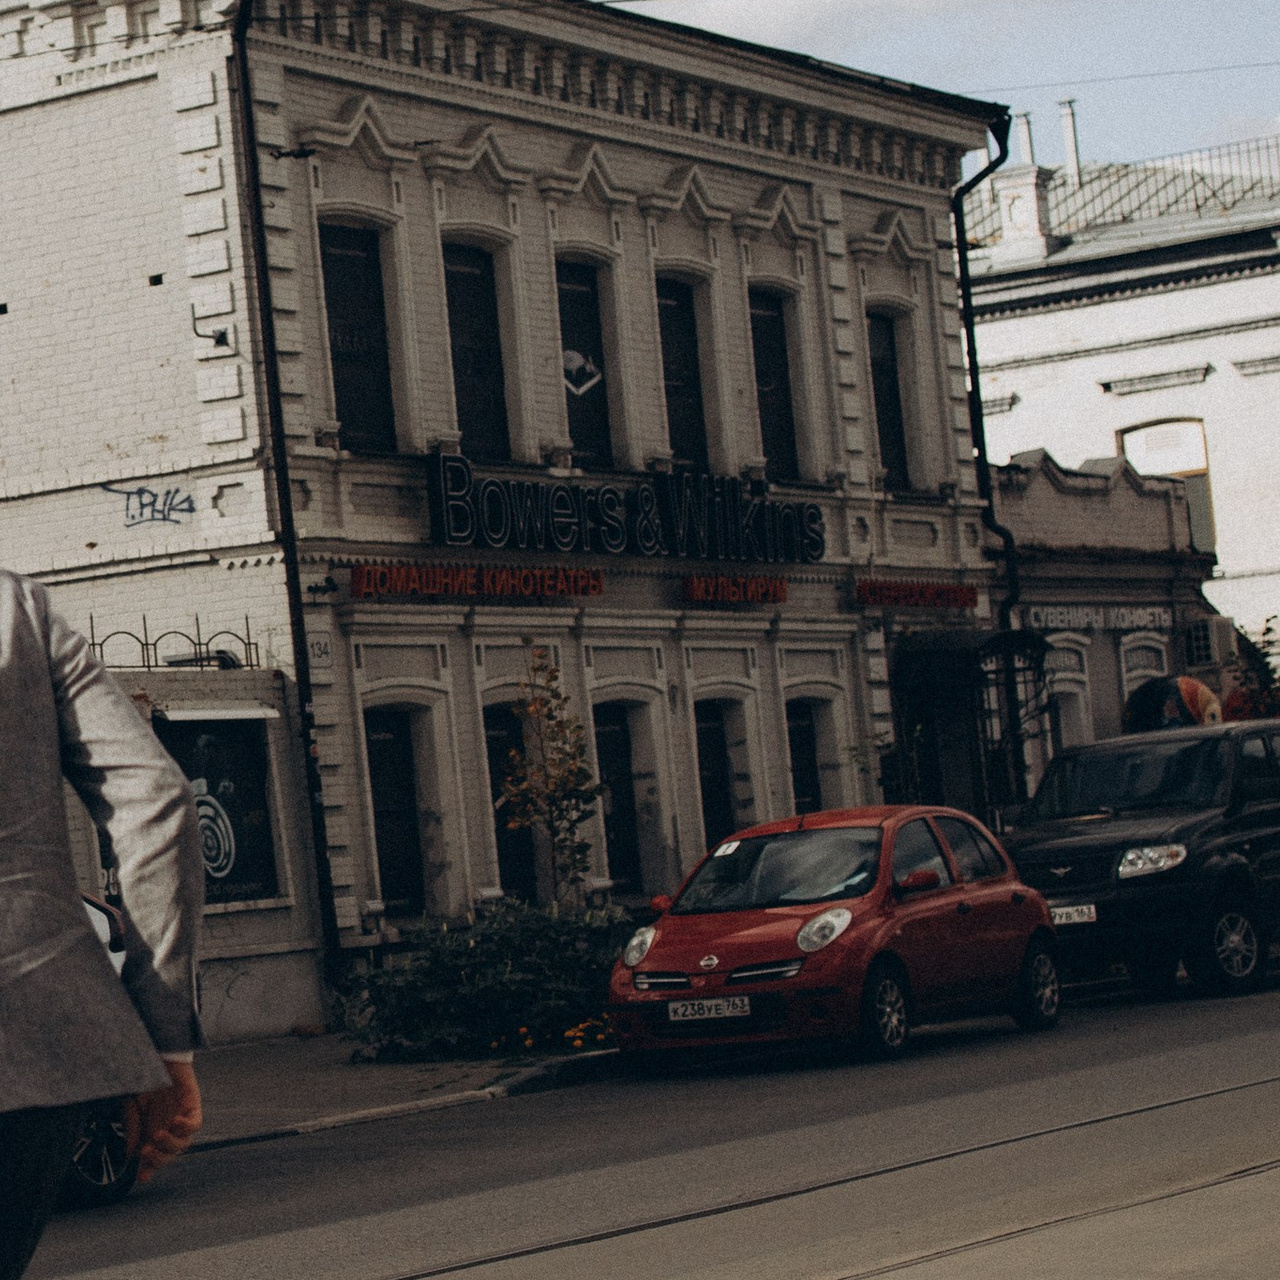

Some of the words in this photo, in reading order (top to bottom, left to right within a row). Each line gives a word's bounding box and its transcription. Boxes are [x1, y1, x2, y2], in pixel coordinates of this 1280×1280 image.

[359, 565, 478, 597] ДОМАШНИЕ
[482, 566, 604, 596] КИНОТЕАТРЫ
[689, 575, 787, 603] МУЛЬТИРУМ
[1029, 605, 1105, 629] СУВЕНИРЫ
[1109, 606, 1173, 628] КОНФЕТЫ
[310, 641, 330, 659] 134
